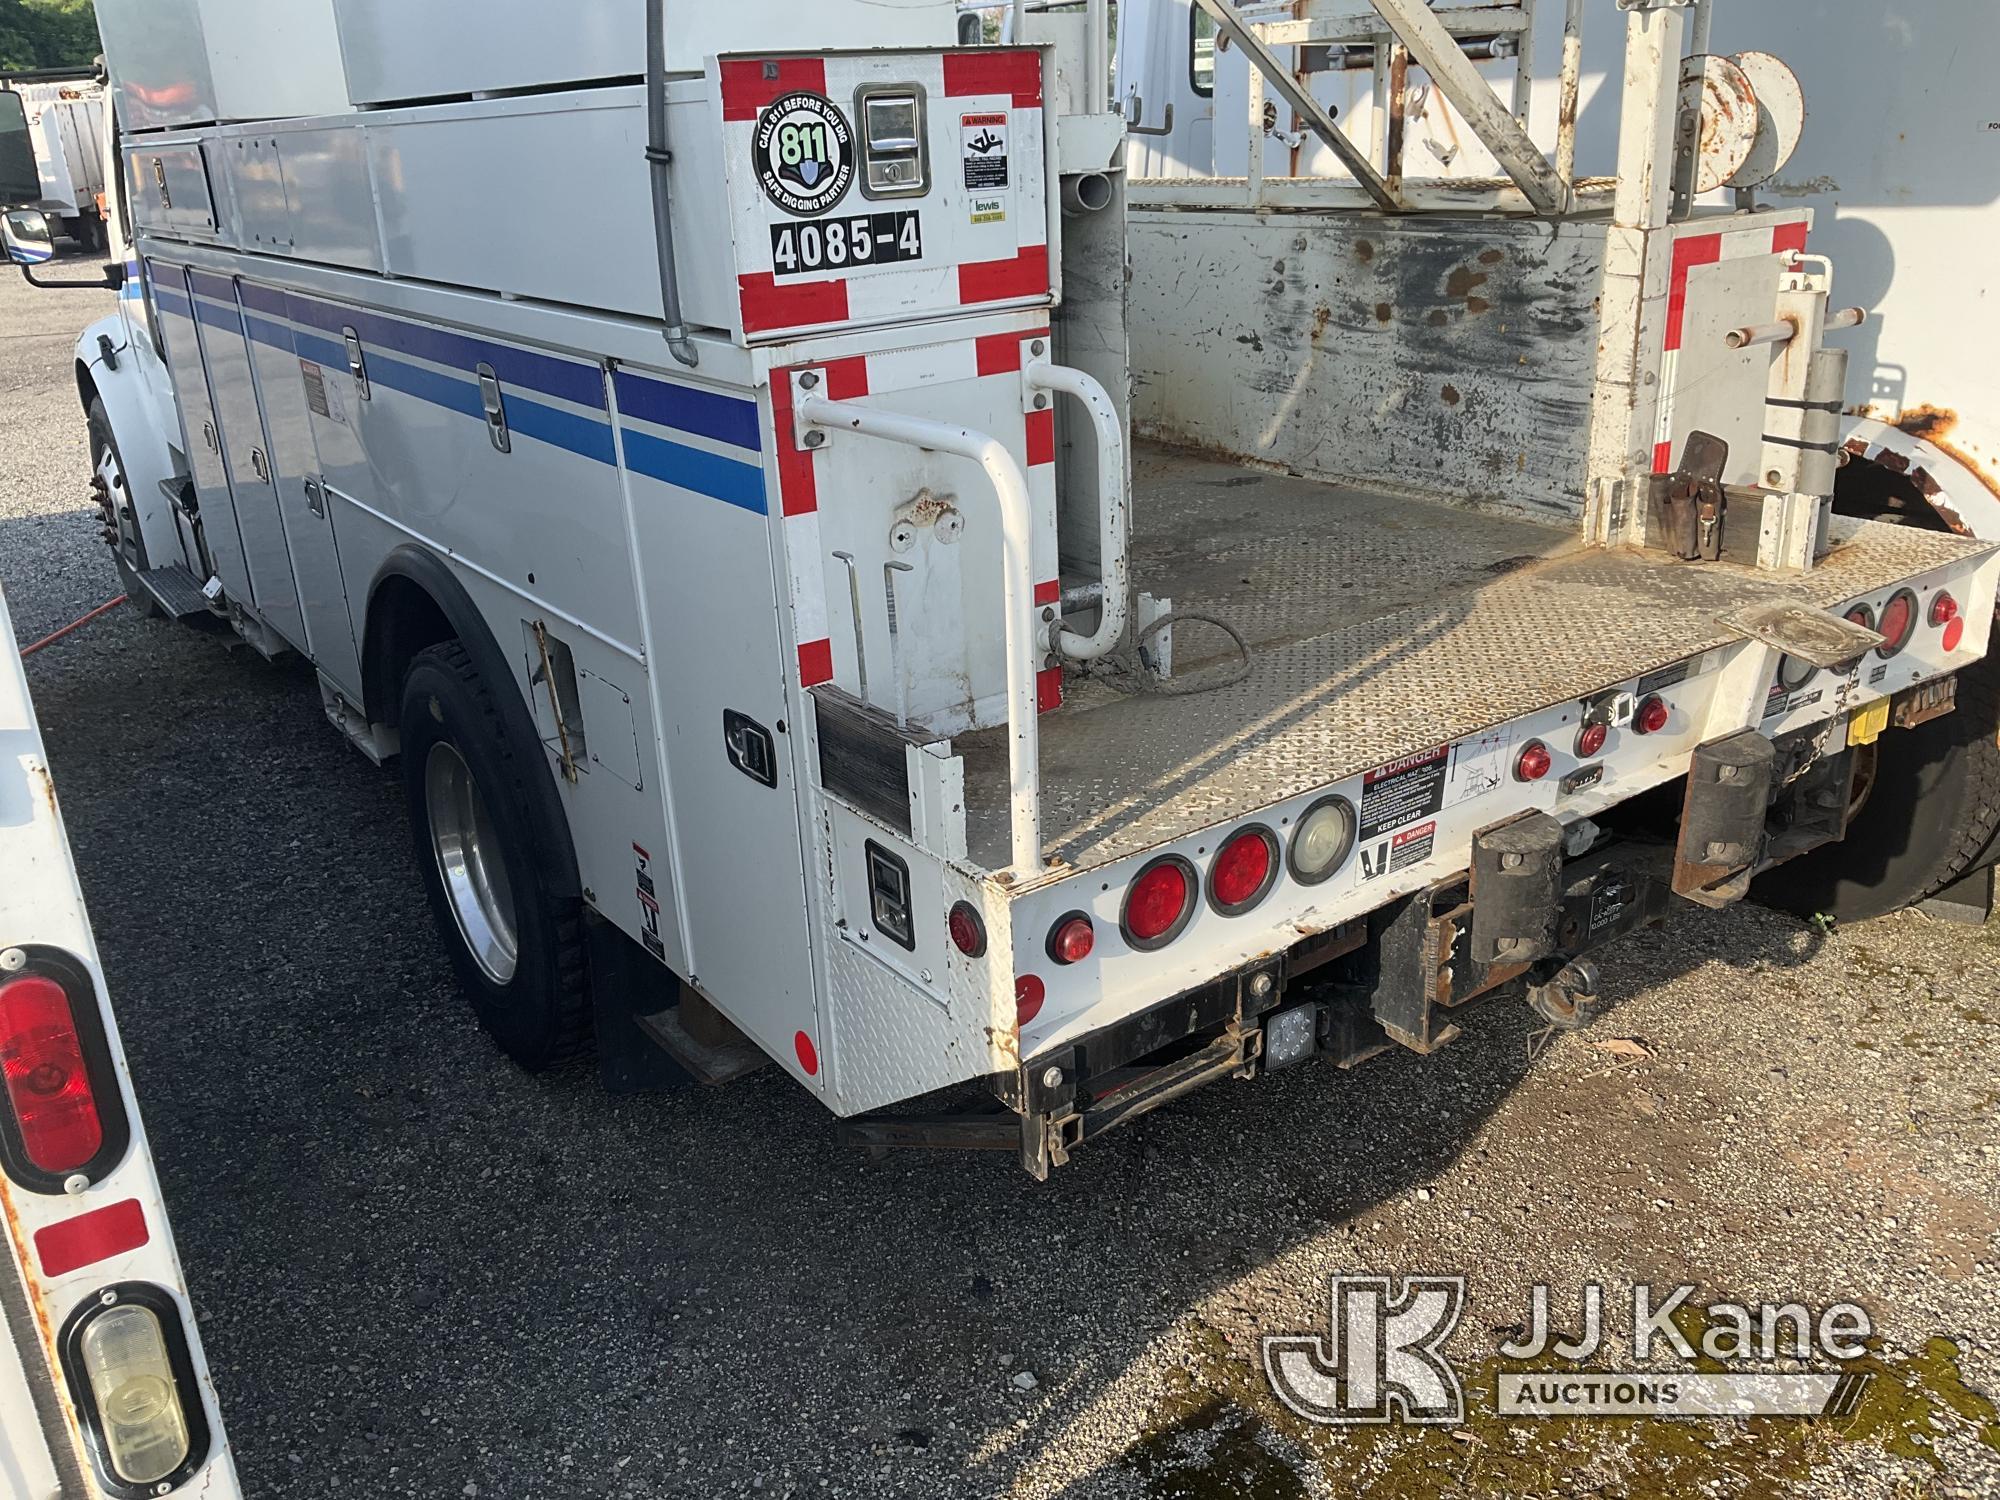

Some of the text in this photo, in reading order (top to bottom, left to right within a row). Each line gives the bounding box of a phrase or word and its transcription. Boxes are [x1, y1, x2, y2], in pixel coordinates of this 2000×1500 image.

[759, 97, 848, 149] CALL 811 BEFORE YOU DIG
[972, 115, 1004, 124] WARNING
[781, 126, 826, 165] 811
[763, 170, 783, 199] SAFE
[781, 191, 820, 211] DIGGING
[820, 164, 850, 206] PARTNER
[975, 200, 1000, 212] lewis
[774, 216, 920, 270] 4085-4
[1388, 746, 1441, 773] DANGER
[1373, 774, 1406, 791] ELECTRICAL
[1377, 809, 1421, 833] KEEP CLEAR
[1406, 823, 1432, 839] DANGER
